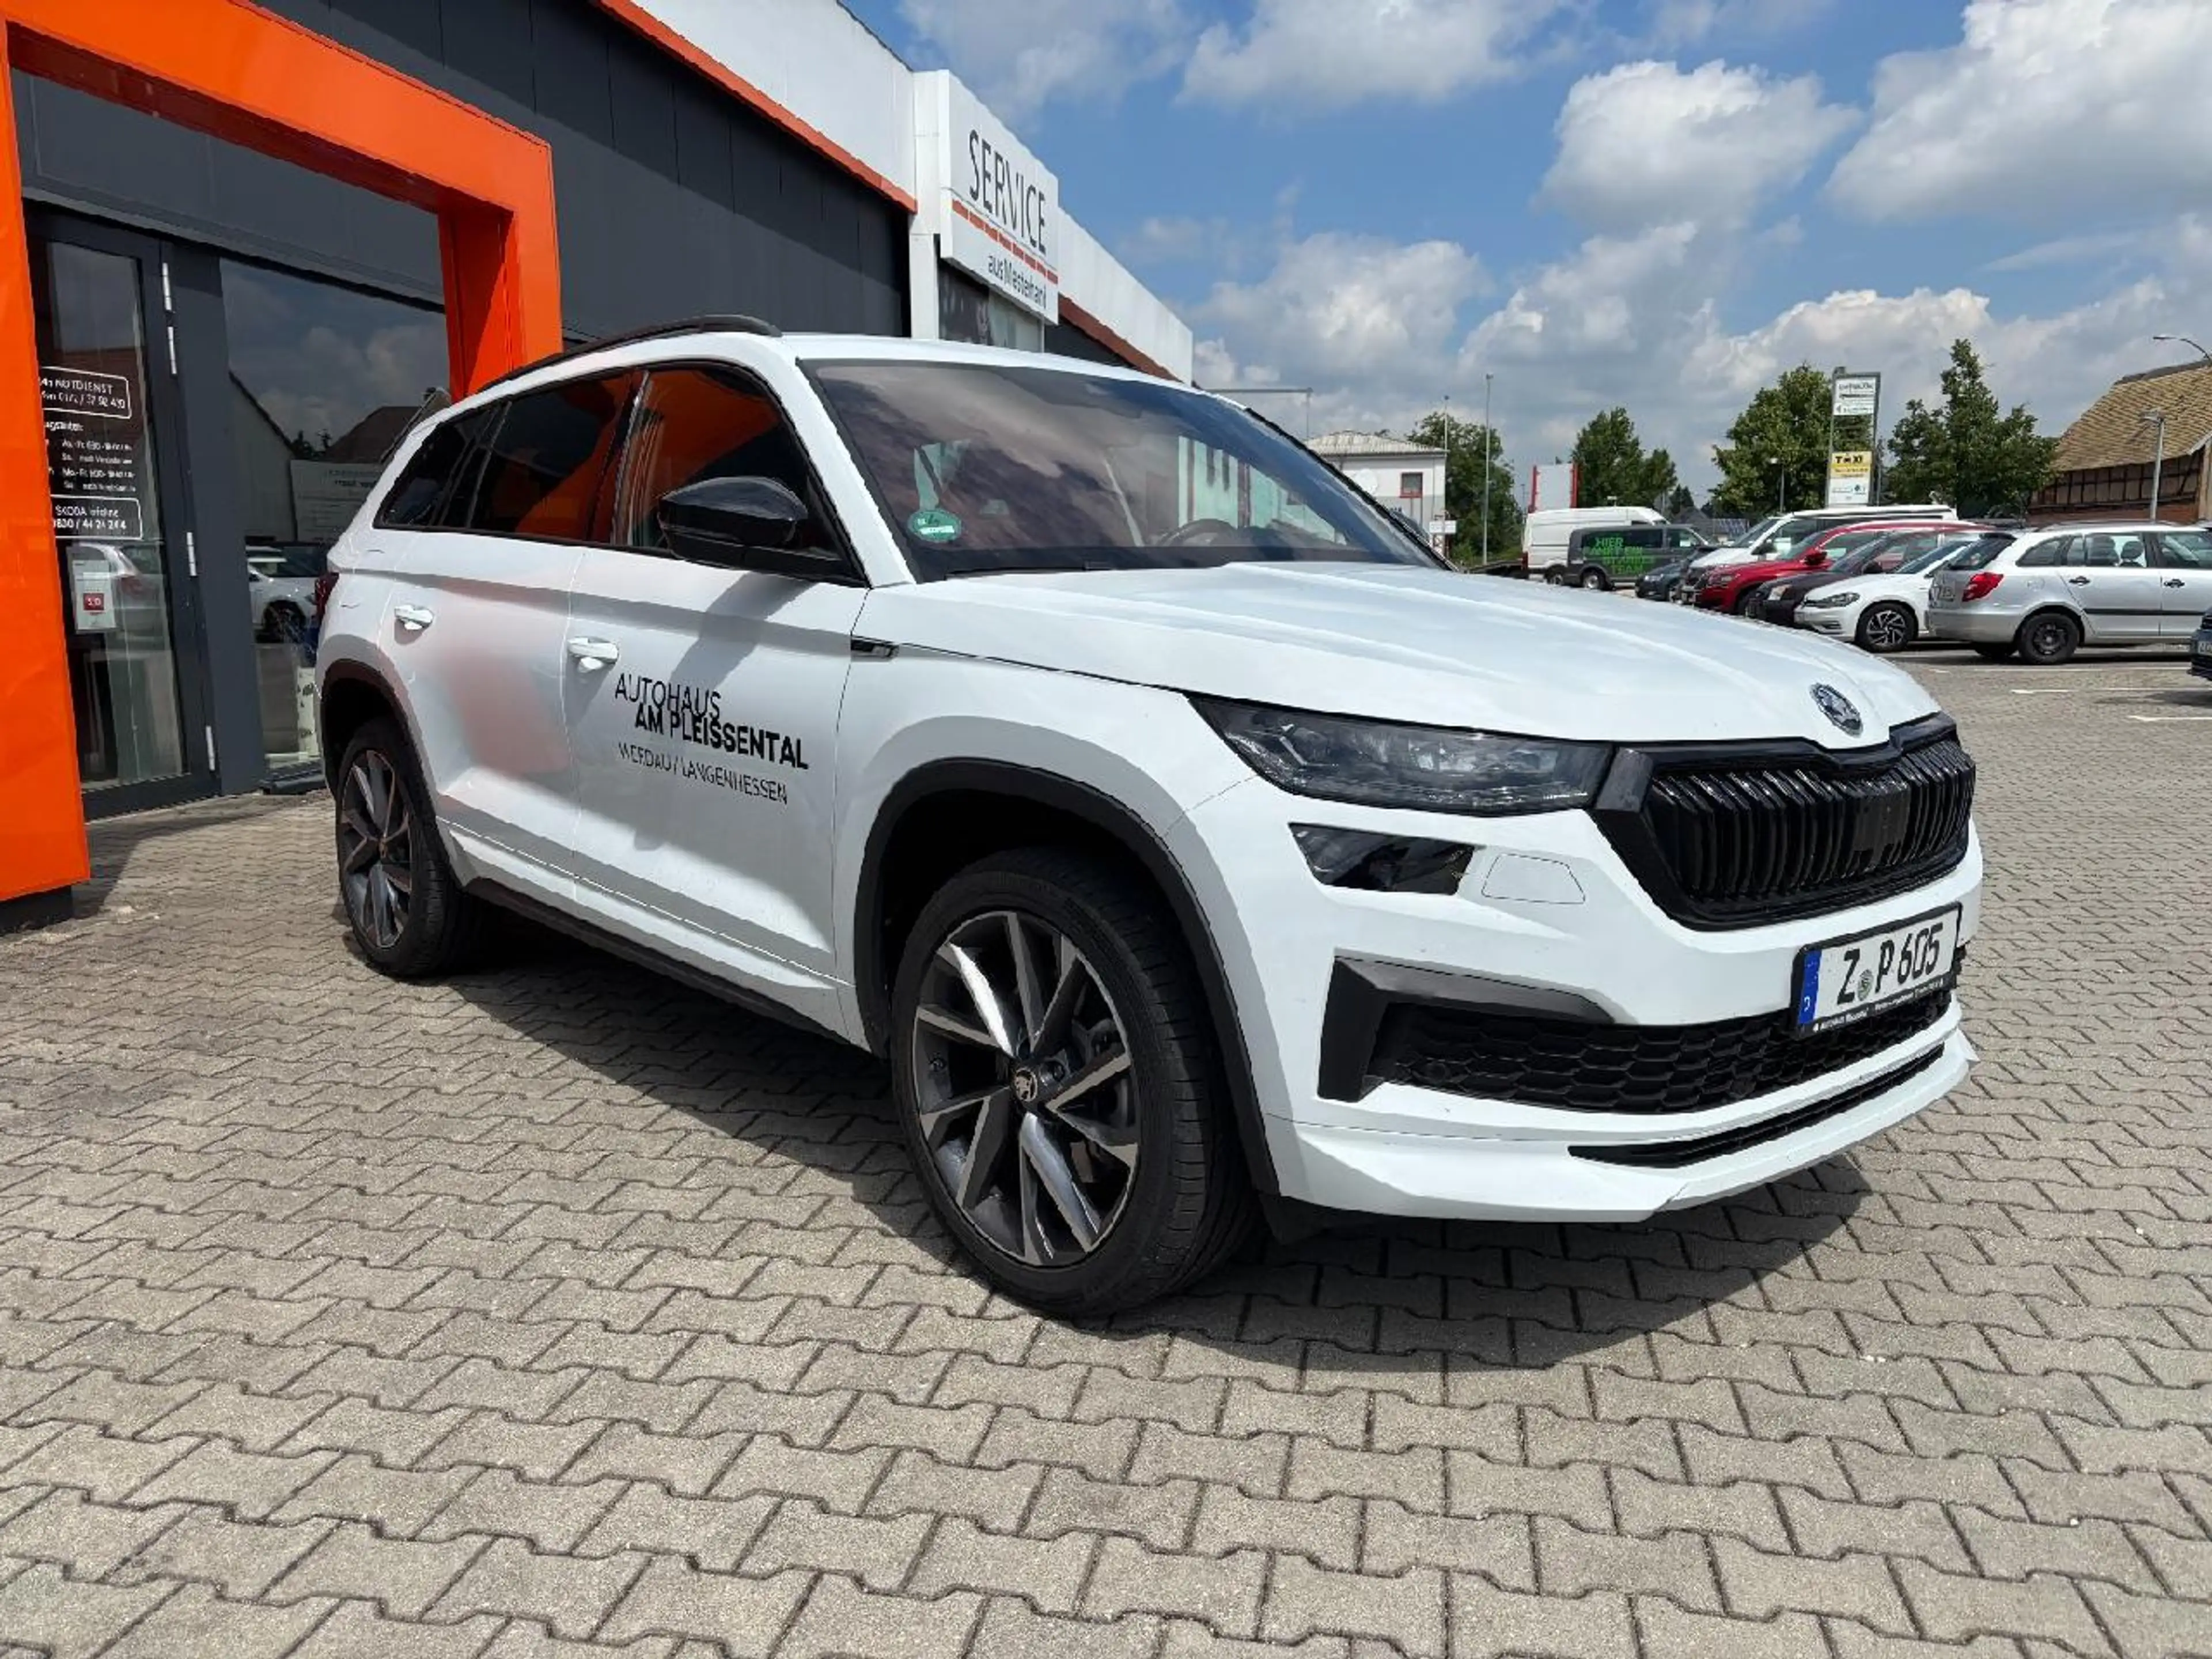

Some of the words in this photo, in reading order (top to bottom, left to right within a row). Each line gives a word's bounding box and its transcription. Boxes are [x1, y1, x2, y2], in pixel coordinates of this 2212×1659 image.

[969, 129, 1046, 255] SERVICE
[615, 673, 721, 721] AUTOHAUS
[635, 702, 664, 735] AM
[671, 710, 809, 770] PLEISSENTAL
[682, 759, 787, 805] LANGENHESSEN
[1837, 948, 1861, 1005] Z
